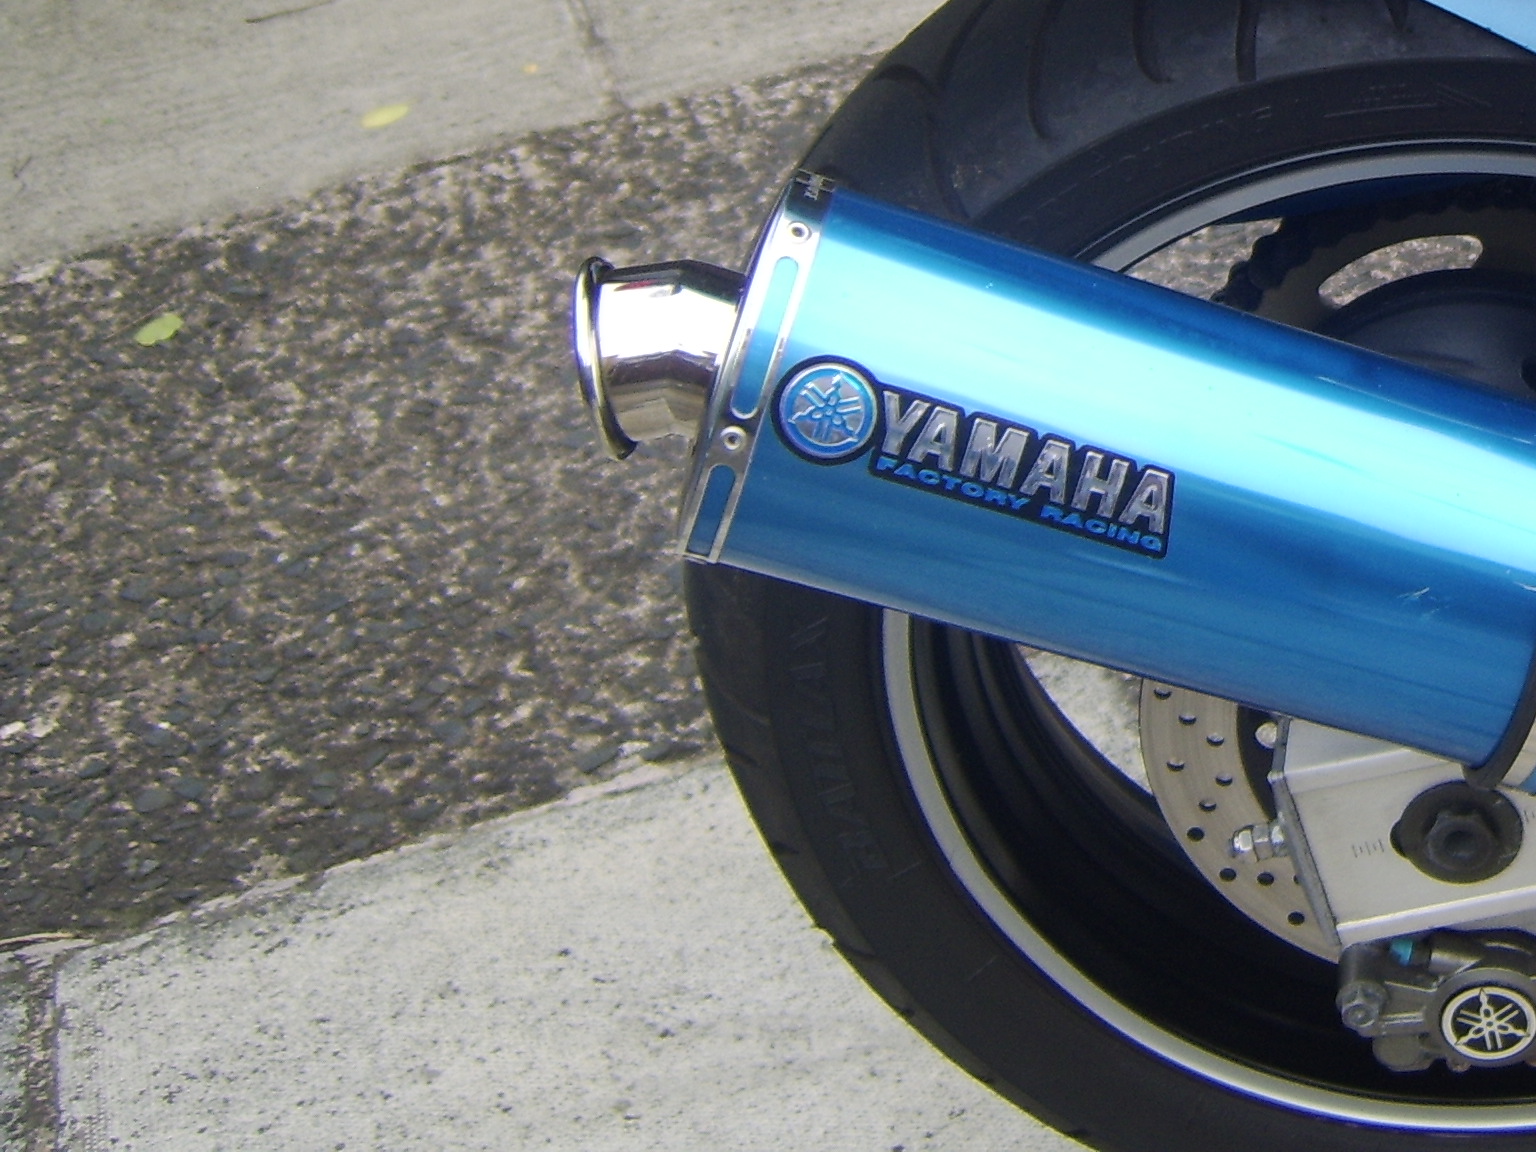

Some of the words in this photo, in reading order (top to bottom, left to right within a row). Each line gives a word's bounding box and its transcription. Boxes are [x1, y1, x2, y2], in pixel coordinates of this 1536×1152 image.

[875, 455, 1032, 511] FACTORY
[1040, 503, 1163, 552] RACING
[883, 389, 1172, 535] YAMAHA
